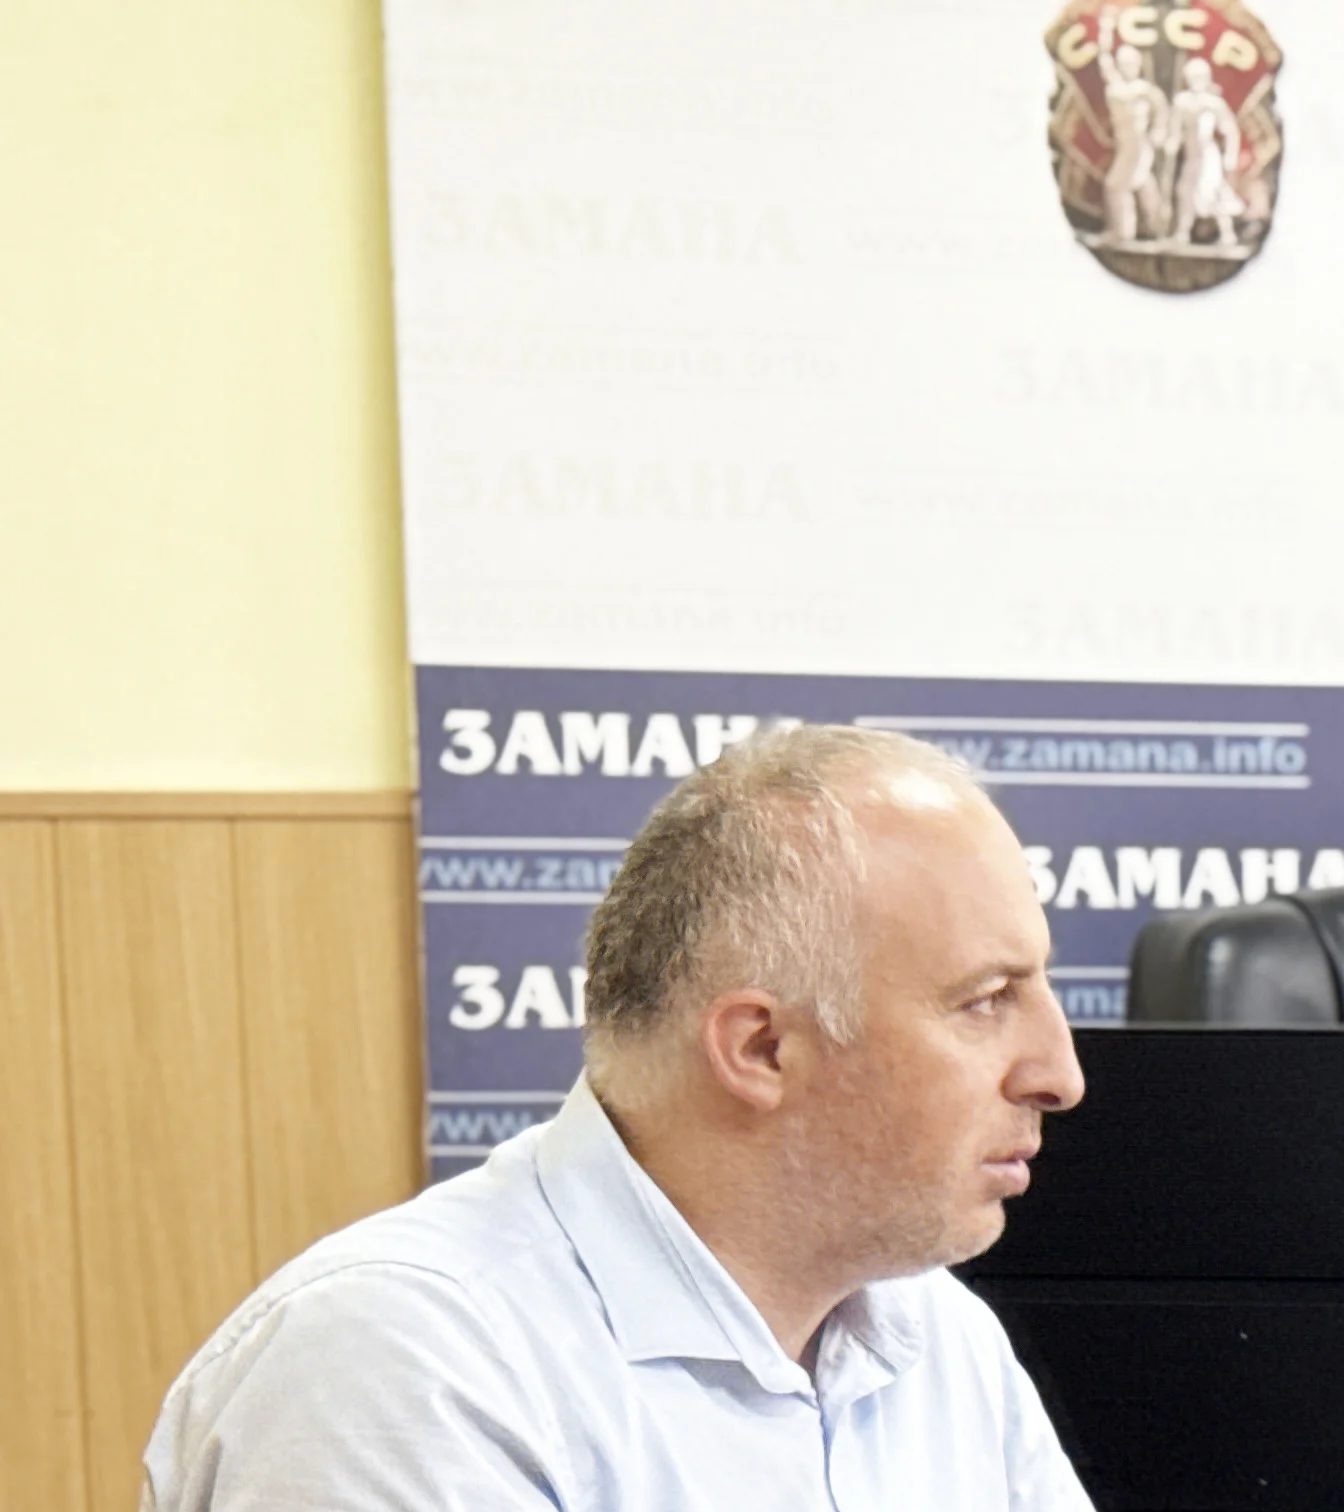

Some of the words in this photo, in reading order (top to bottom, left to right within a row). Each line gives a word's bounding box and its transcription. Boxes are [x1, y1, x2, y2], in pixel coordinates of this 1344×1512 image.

[1056, 5, 1260, 72] СССР
[424, 193, 806, 264] ЗАМАНА
[434, 453, 812, 525] ЗАМАНА
[440, 709, 803, 776] ЗАМАН
